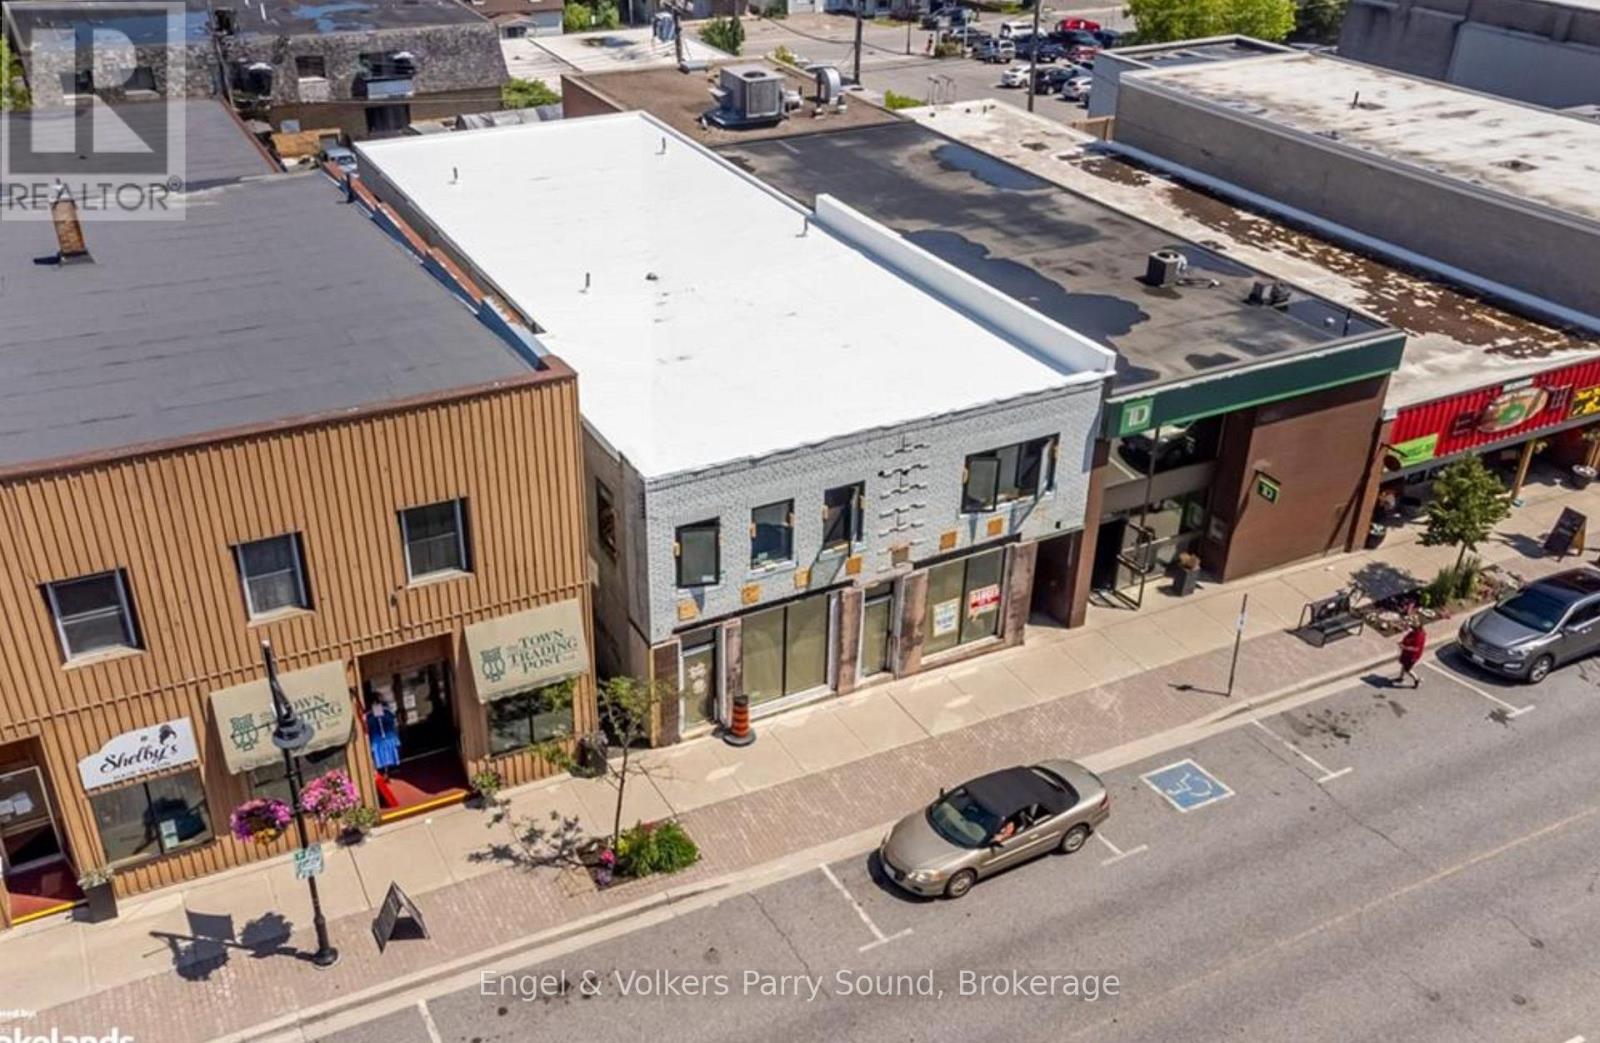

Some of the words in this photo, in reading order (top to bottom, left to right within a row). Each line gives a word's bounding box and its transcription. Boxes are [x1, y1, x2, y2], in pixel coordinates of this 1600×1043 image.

[1127, 405, 1149, 427] TD
[518, 628, 565, 649] TOWN
[507, 637, 578, 666] TRADING
[521, 656, 561, 673] POST
[100, 744, 178, 773] Shelby's
